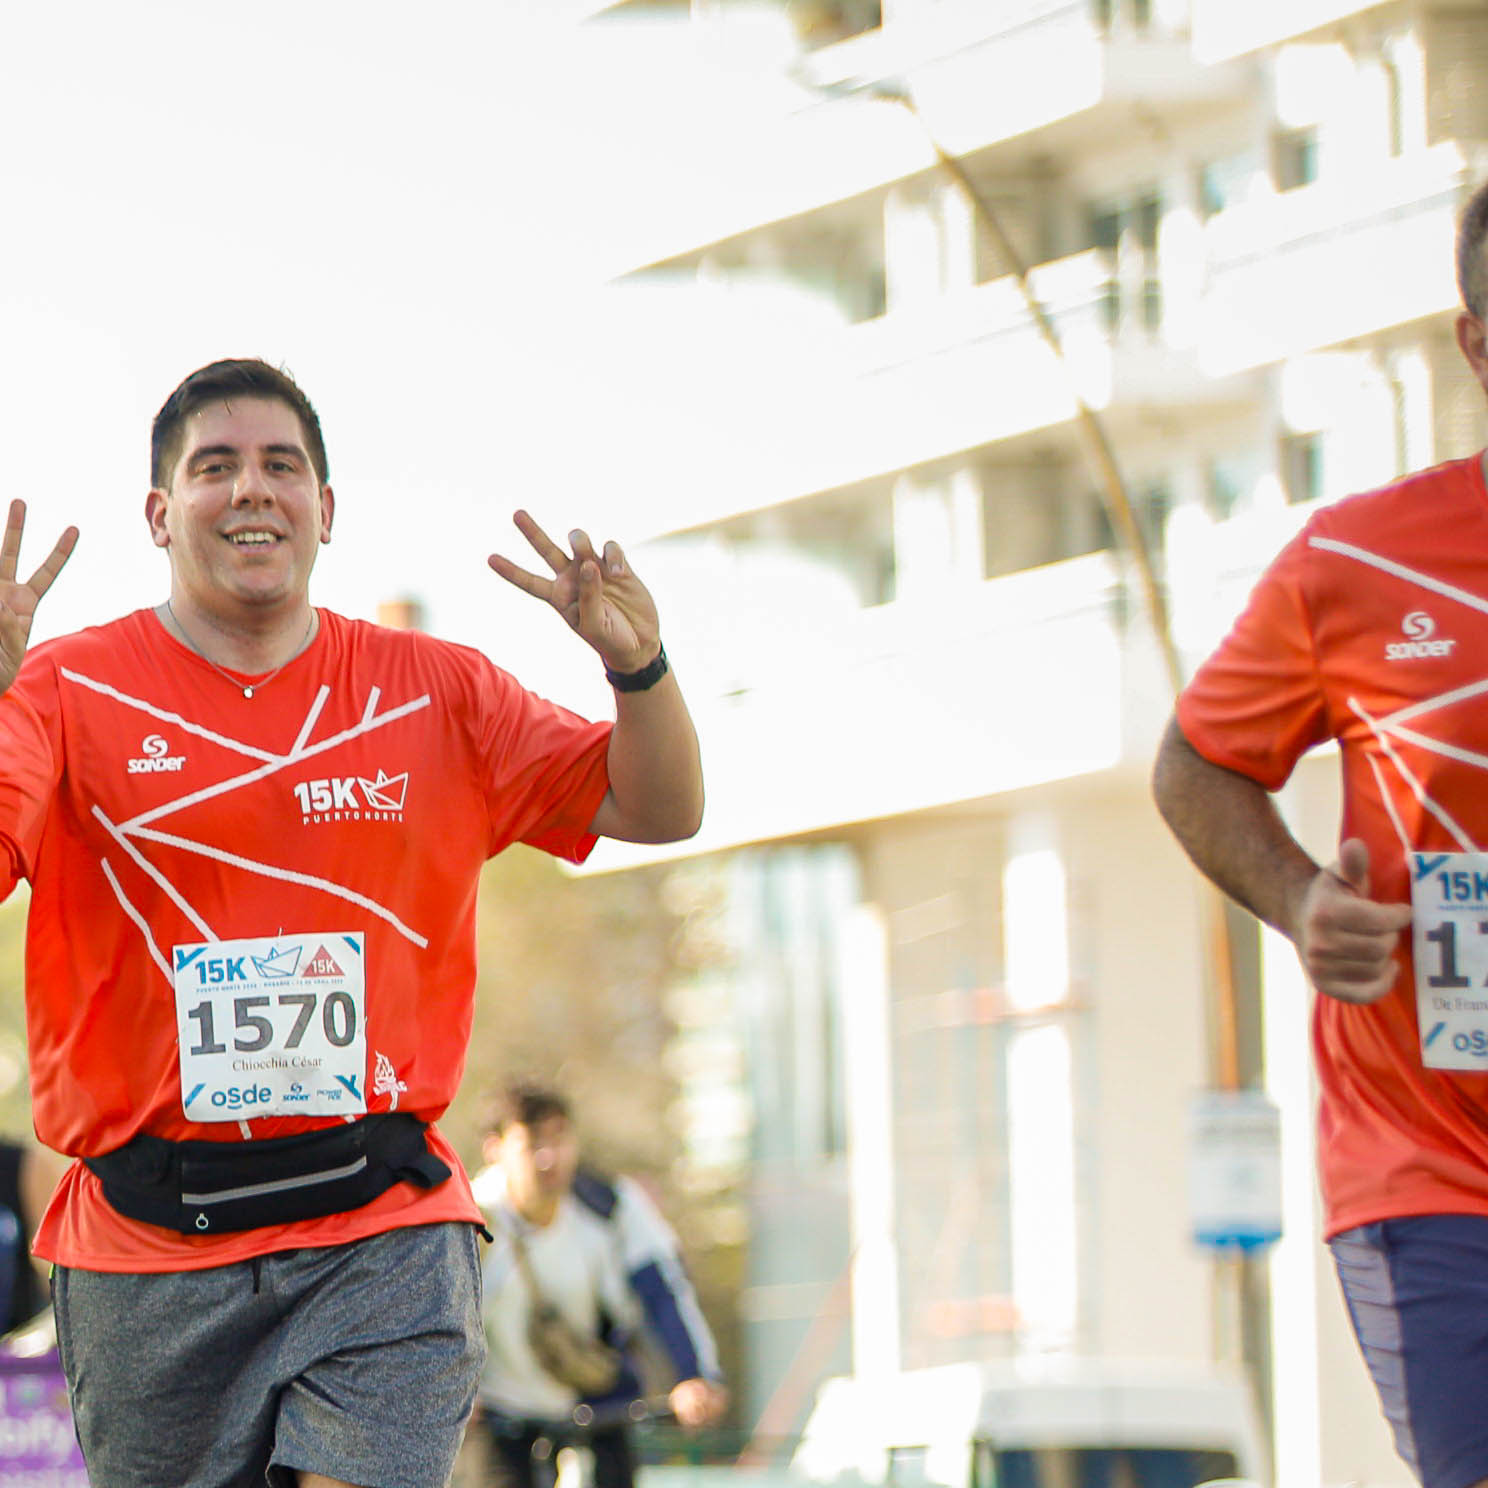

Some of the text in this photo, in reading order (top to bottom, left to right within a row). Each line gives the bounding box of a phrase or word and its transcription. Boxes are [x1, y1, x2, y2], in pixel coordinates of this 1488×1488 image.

[294, 777, 359, 814] 15K
[195, 957, 247, 985] 15K
[311, 959, 337, 974] 15K
[1426, 921, 1488, 988] 1
[188, 991, 356, 1056] 1570
